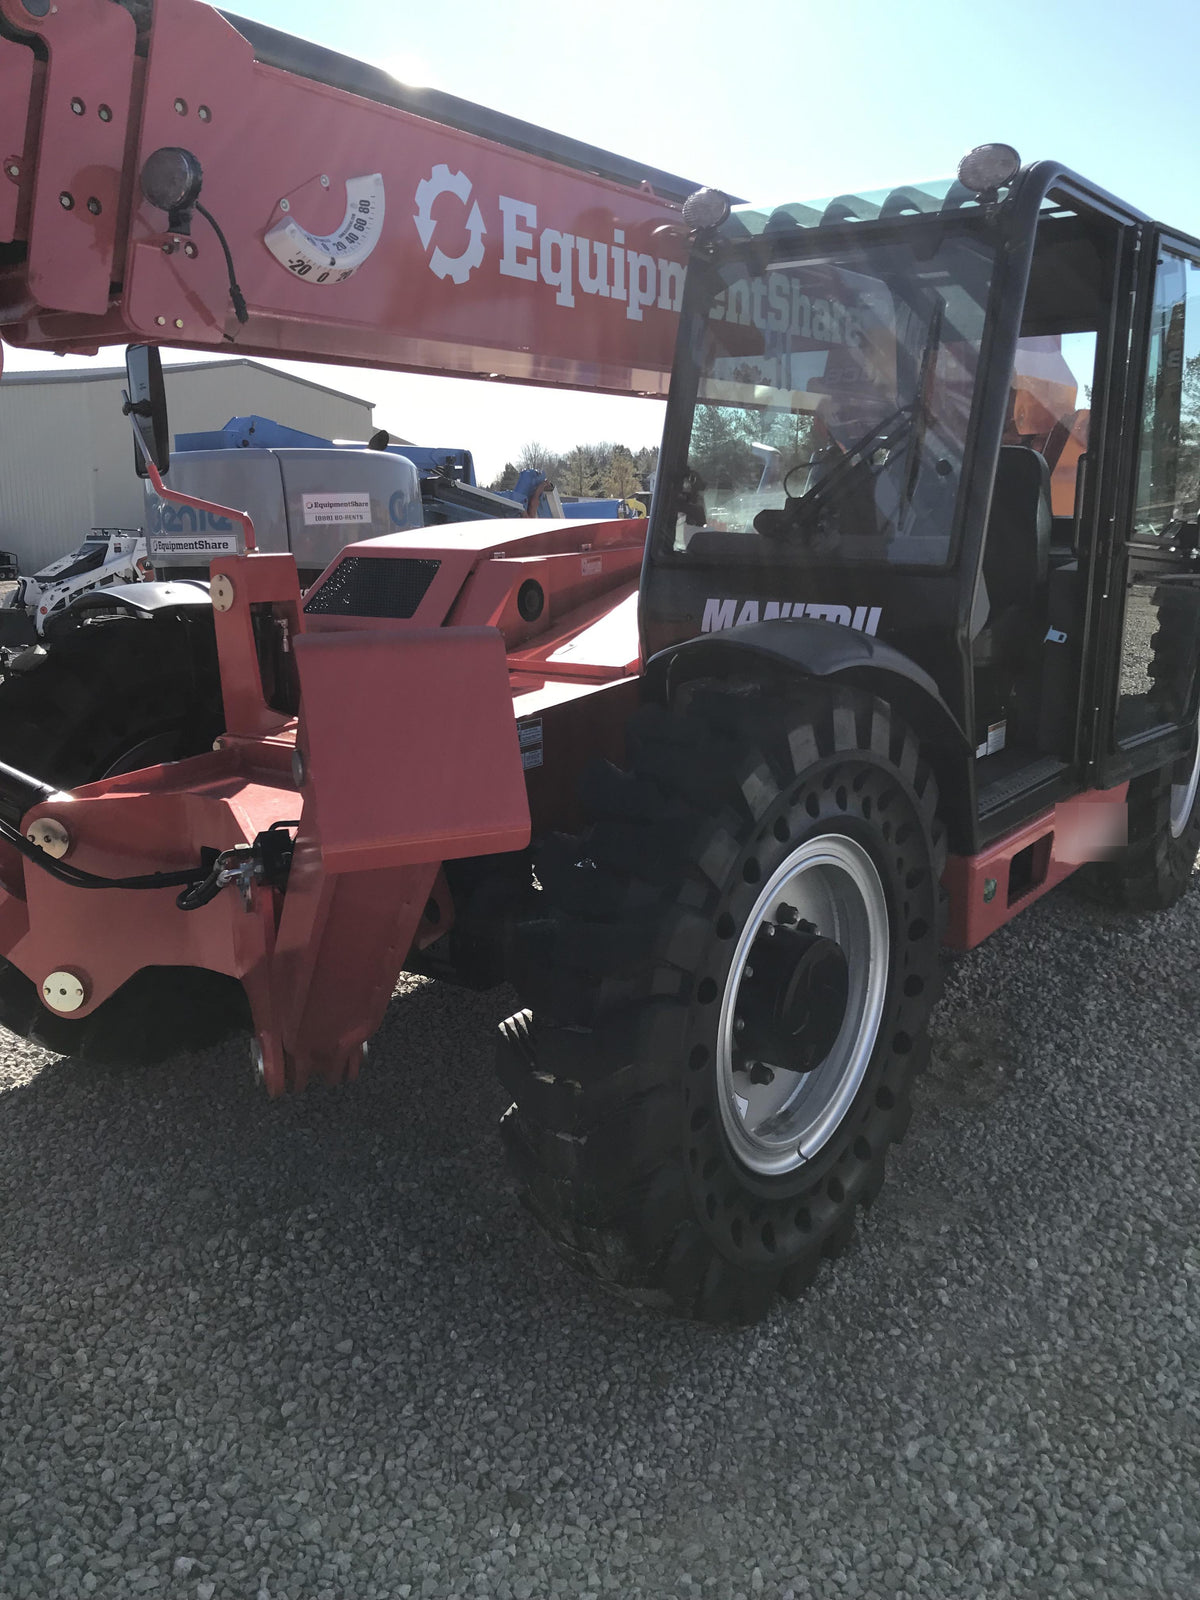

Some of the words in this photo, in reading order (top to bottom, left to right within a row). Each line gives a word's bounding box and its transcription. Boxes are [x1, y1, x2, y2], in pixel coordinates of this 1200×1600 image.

[358, 199, 371, 214] 80
[354, 217, 367, 232] 60
[345, 232, 359, 245] 40
[288, 259, 312, 276] -20
[316, 272, 330, 283] 0
[314, 500, 369, 509] EquipmentShare
[158, 540, 229, 552] EquipmentShare
